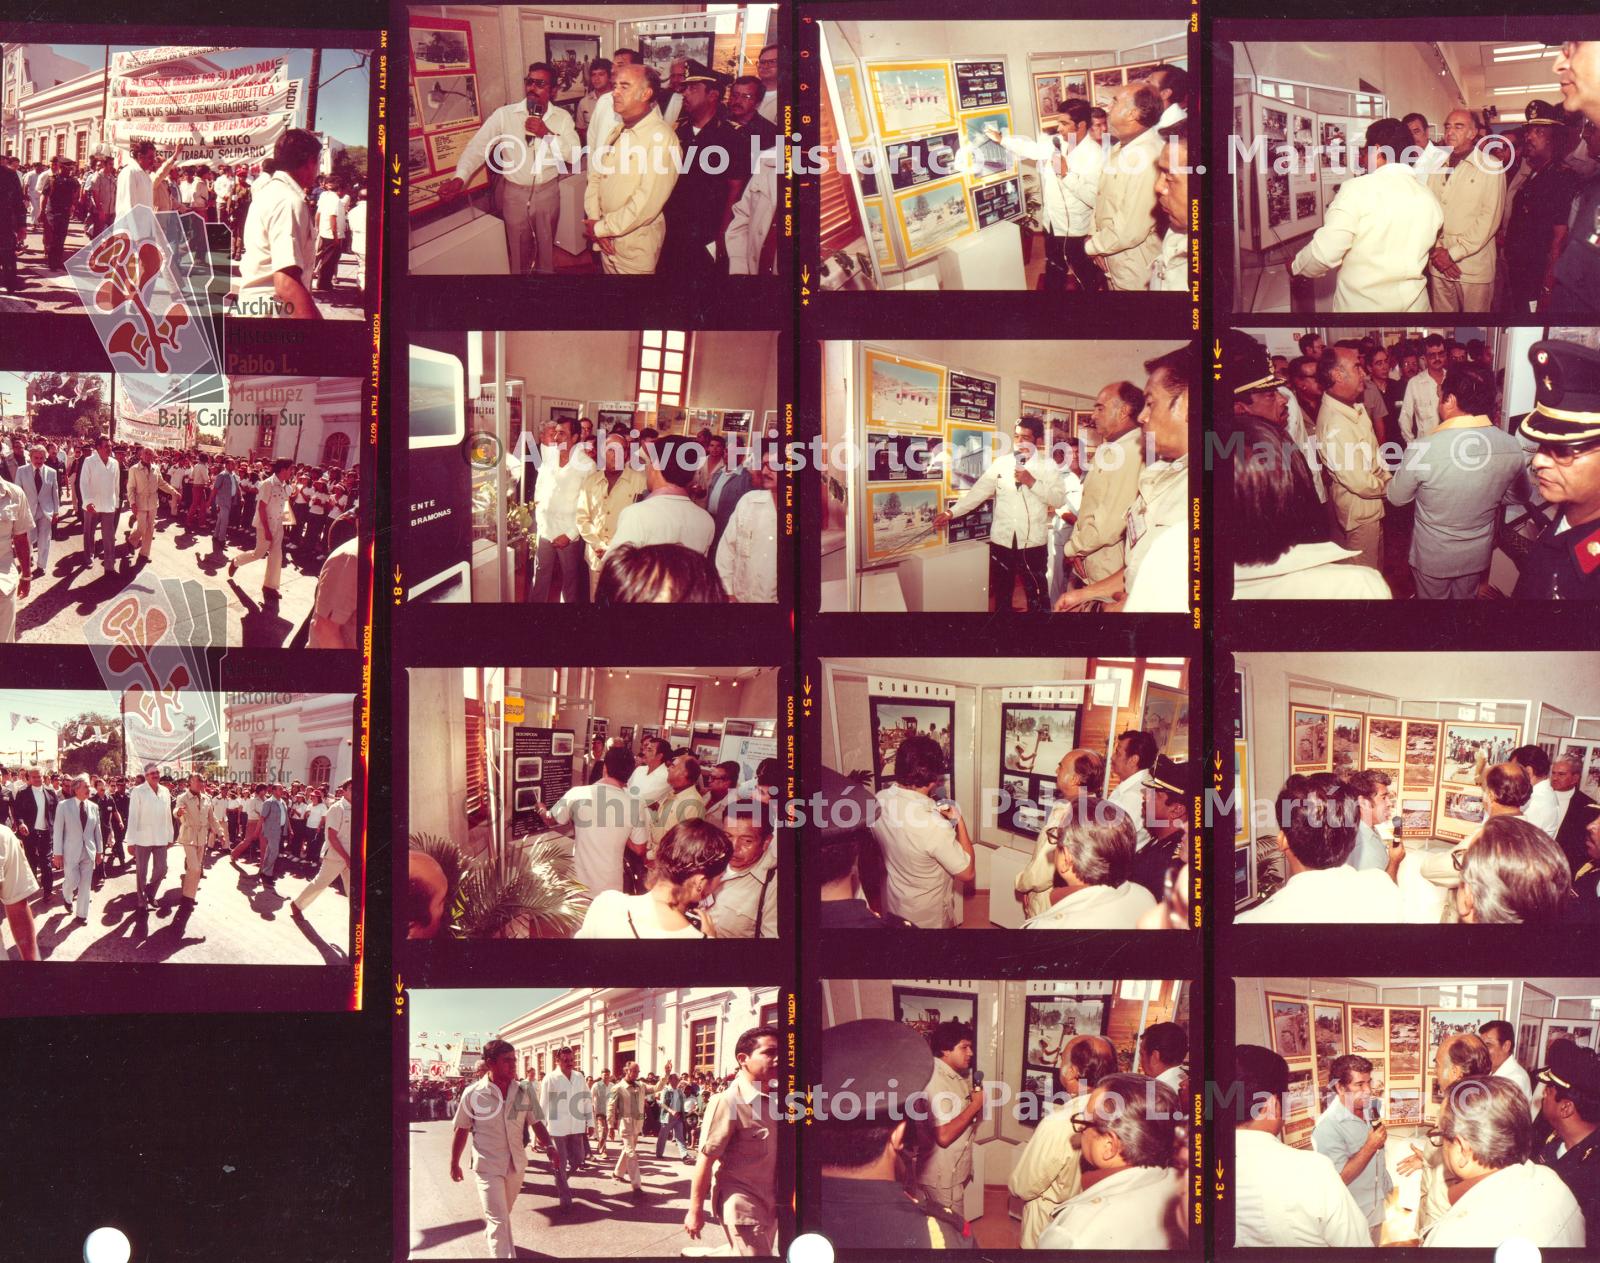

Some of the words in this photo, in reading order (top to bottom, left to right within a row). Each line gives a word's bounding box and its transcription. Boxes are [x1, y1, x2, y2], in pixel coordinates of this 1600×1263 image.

[202, 72, 215, 83] POR
[218, 70, 227, 81] SU
[230, 65, 254, 80] APOYO
[256, 60, 275, 74] PARA
[380, 55, 388, 90] SAFETY
[219, 90, 228, 100] SU
[378, 97, 386, 118] FILM
[784, 106, 792, 138] KODAK
[200, 137, 206, 146] A
[213, 134, 250, 146] MEXICO
[377, 124, 386, 146] 6075
[181, 150, 214, 160] TRABAJO
[218, 146, 266, 160] SOLIDARIO
[784, 186, 792, 208] FILM
[784, 214, 792, 236] 6075
[372, 314, 380, 346] KODAK
[370, 395, 378, 416] FILM
[410, 500, 436, 512] ENTE
[410, 508, 452, 526] BRAMONAS
[362, 664, 370, 700] SAFETY
[360, 734, 368, 756] 6075
[1194, 796, 1202, 828] KODAK
[1194, 836, 1202, 871] SAFETY
[1194, 878, 1202, 899] FILM
[1194, 906, 1202, 928] 6075
[354, 924, 362, 956] KODAK
